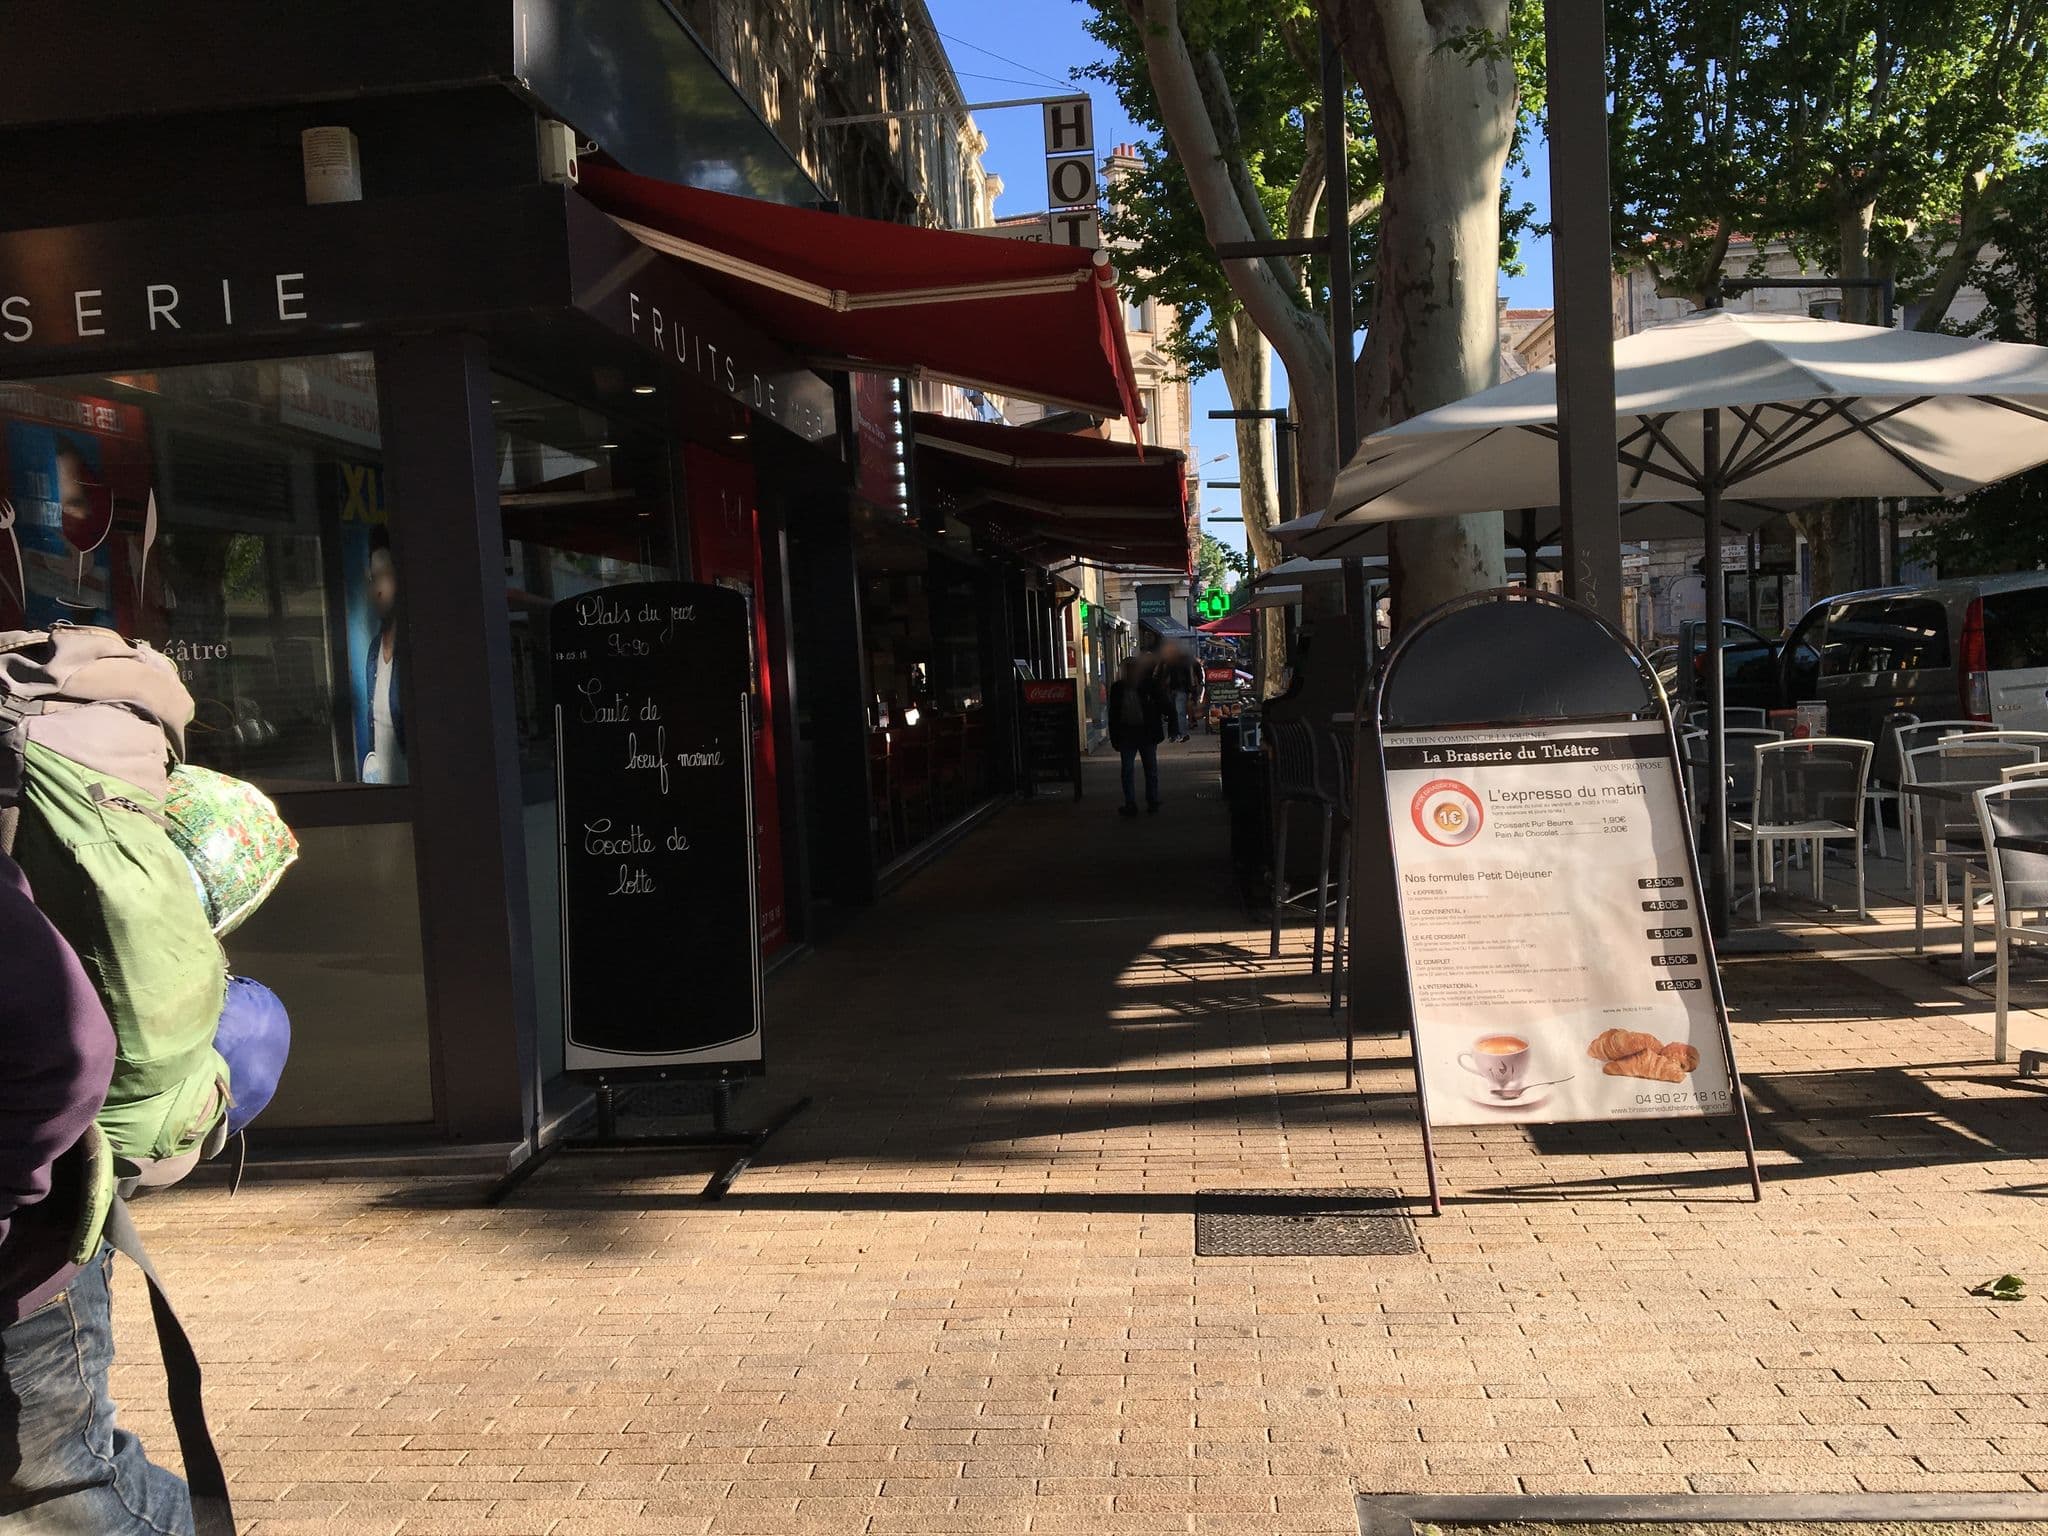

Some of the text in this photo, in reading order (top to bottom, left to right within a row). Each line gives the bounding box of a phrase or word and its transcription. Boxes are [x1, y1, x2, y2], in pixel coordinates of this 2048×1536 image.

[1, 272, 308, 343] SERIE
[629, 291, 736, 392] FRUITS
[752, 374, 777, 417] DE
[576, 595, 696, 646] Plats du jour
[577, 678, 663, 724] Sauté de
[1391, 737, 1415, 745] POUR
[1416, 736, 1436, 744] BIEN
[1422, 744, 1601, 763] La Brasserie du Théâtre
[1592, 762, 1664, 772] VOUS PROPOSE
[1488, 787, 1572, 804] L'expresso
[1577, 785, 1596, 798] du
[1601, 782, 1647, 796] matin
[1439, 810, 1463, 826] 1€
[1493, 821, 1531, 829] Croissant
[1531, 820, 1545, 828] Pur
[1546, 819, 1574, 827] Beurre
[583, 818, 691, 856] Cocotte de
[1495, 831, 1512, 839] Pain
[1514, 830, 1525, 838] Au
[1525, 829, 1560, 837] Chocolat
[1404, 869, 1553, 883] Nos formules Petit Déjeuner
[1635, 1091, 1727, 1104] 04 90 27 18 18
